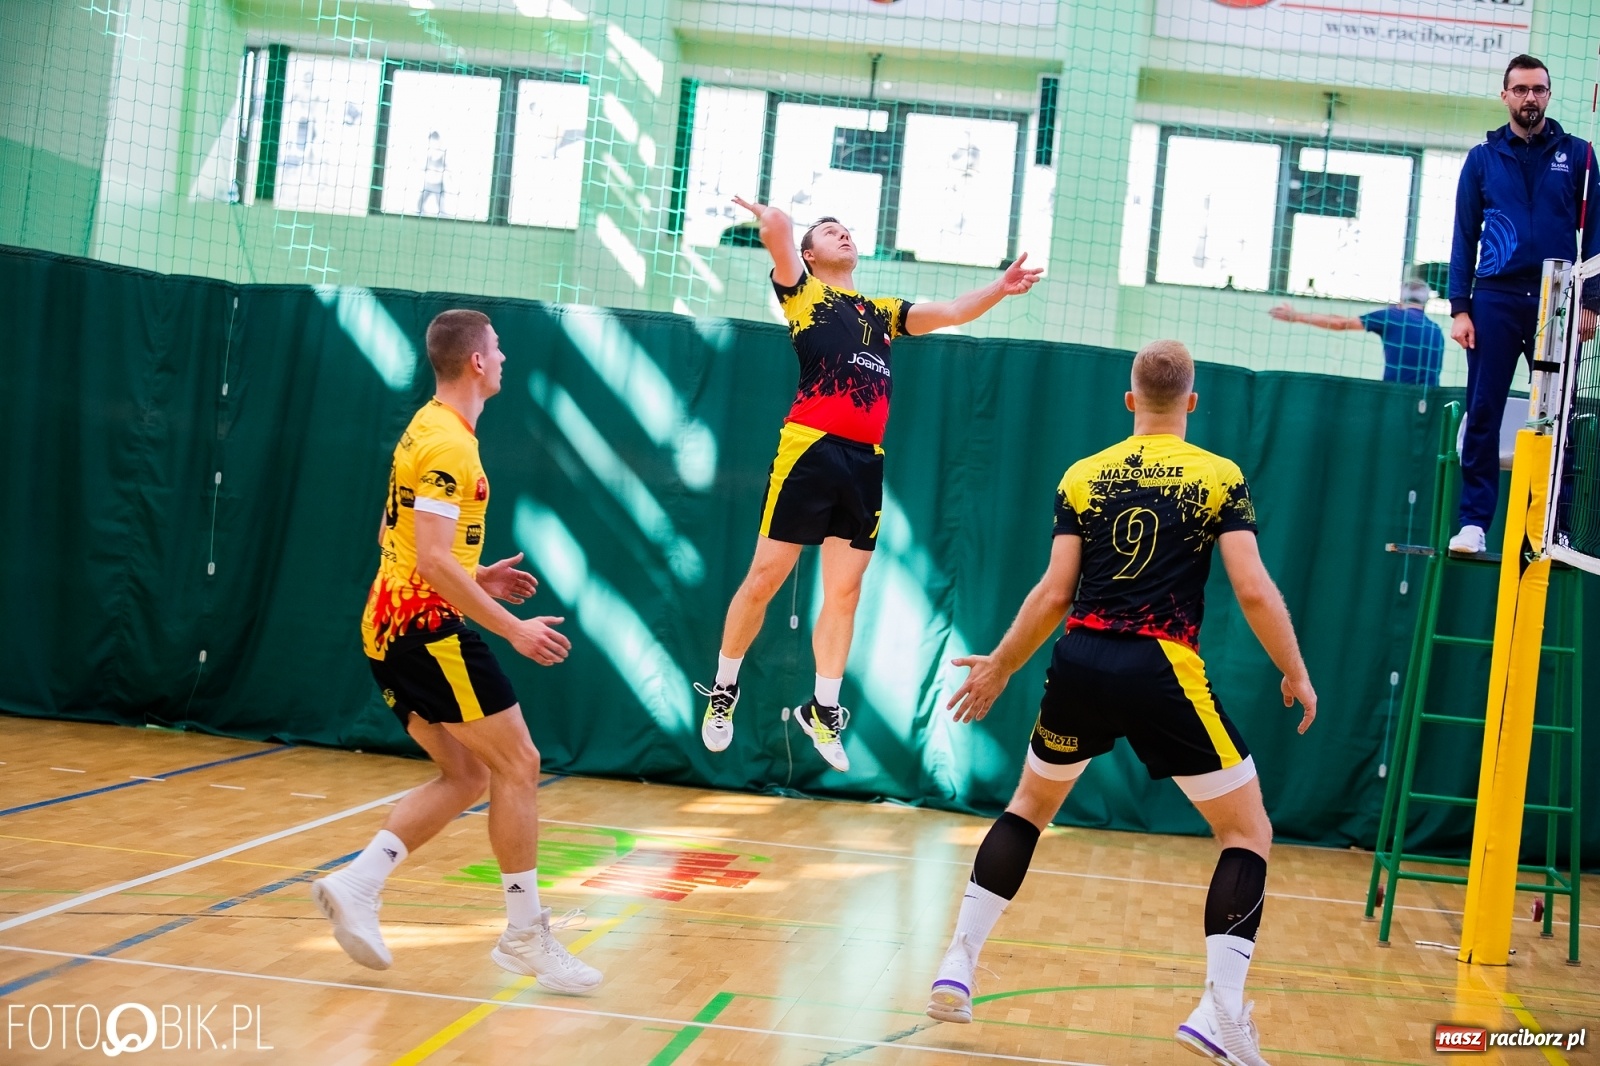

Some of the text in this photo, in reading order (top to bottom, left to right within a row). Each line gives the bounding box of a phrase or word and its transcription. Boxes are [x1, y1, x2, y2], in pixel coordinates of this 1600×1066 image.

[1325, 20, 1503, 52] www.raciborz.pl
[847, 353, 891, 378] Joanna
[1099, 466, 1184, 481] MAZOWSZE
[1112, 506, 1160, 580] 9
